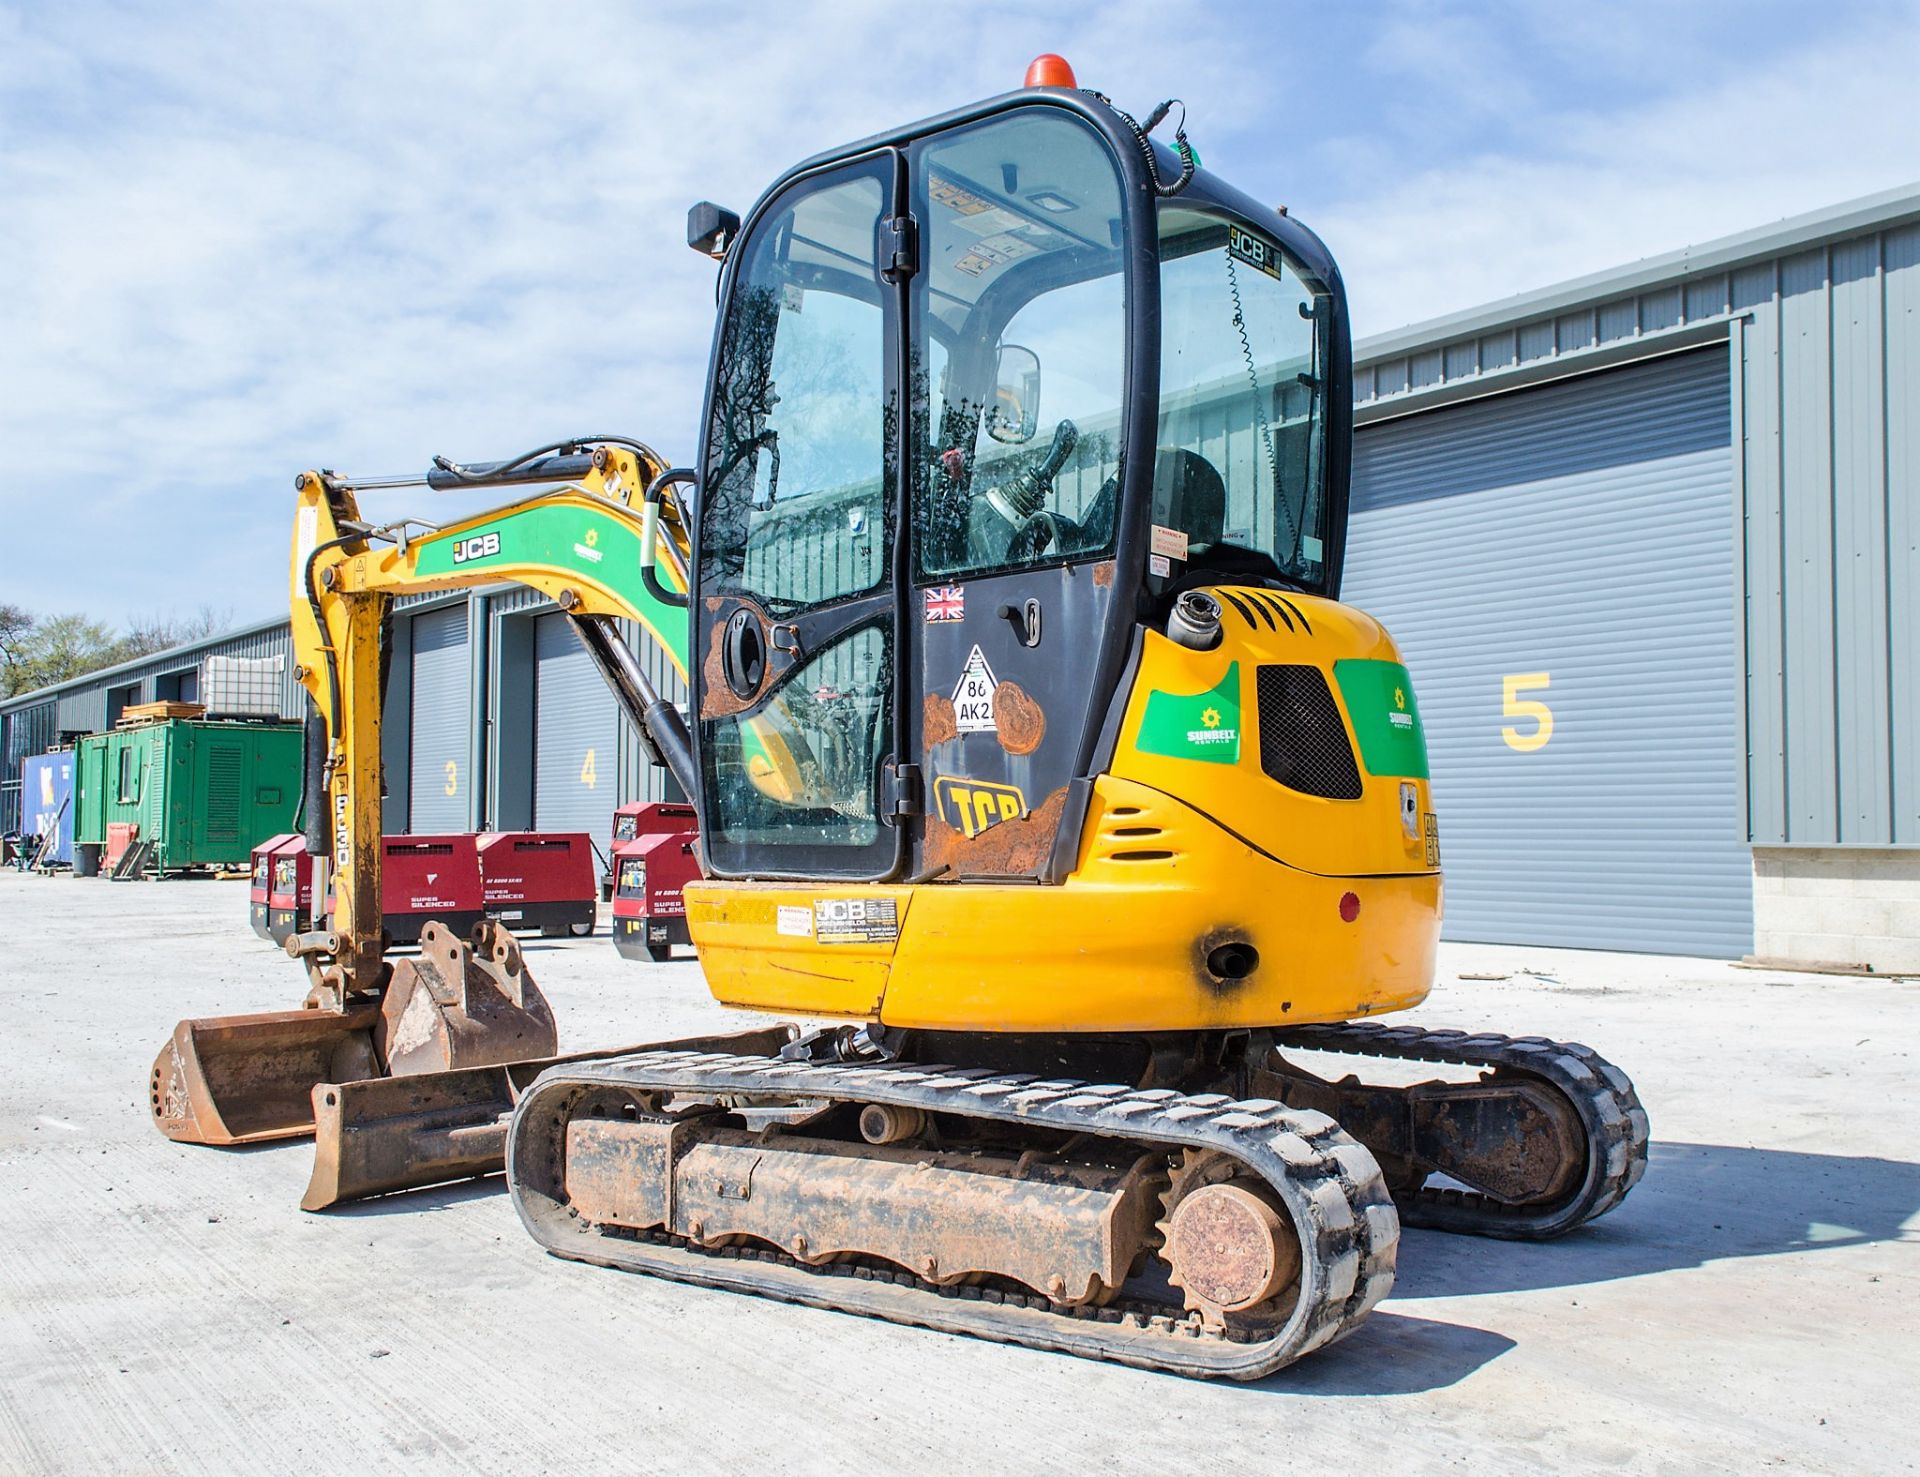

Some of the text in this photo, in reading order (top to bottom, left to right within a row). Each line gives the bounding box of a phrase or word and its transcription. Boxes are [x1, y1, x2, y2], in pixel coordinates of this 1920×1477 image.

[1231, 228, 1264, 262] JCB
[454, 533, 499, 563] JCB
[968, 681, 986, 698] 86
[960, 702, 995, 720] AK2
[1502, 672, 1553, 752] 5
[1187, 729, 1236, 741] SUNBELT
[445, 760, 457, 796] 3
[580, 748, 597, 789] 4
[654, 906, 686, 914] SILENC
[816, 900, 867, 919] JCB
